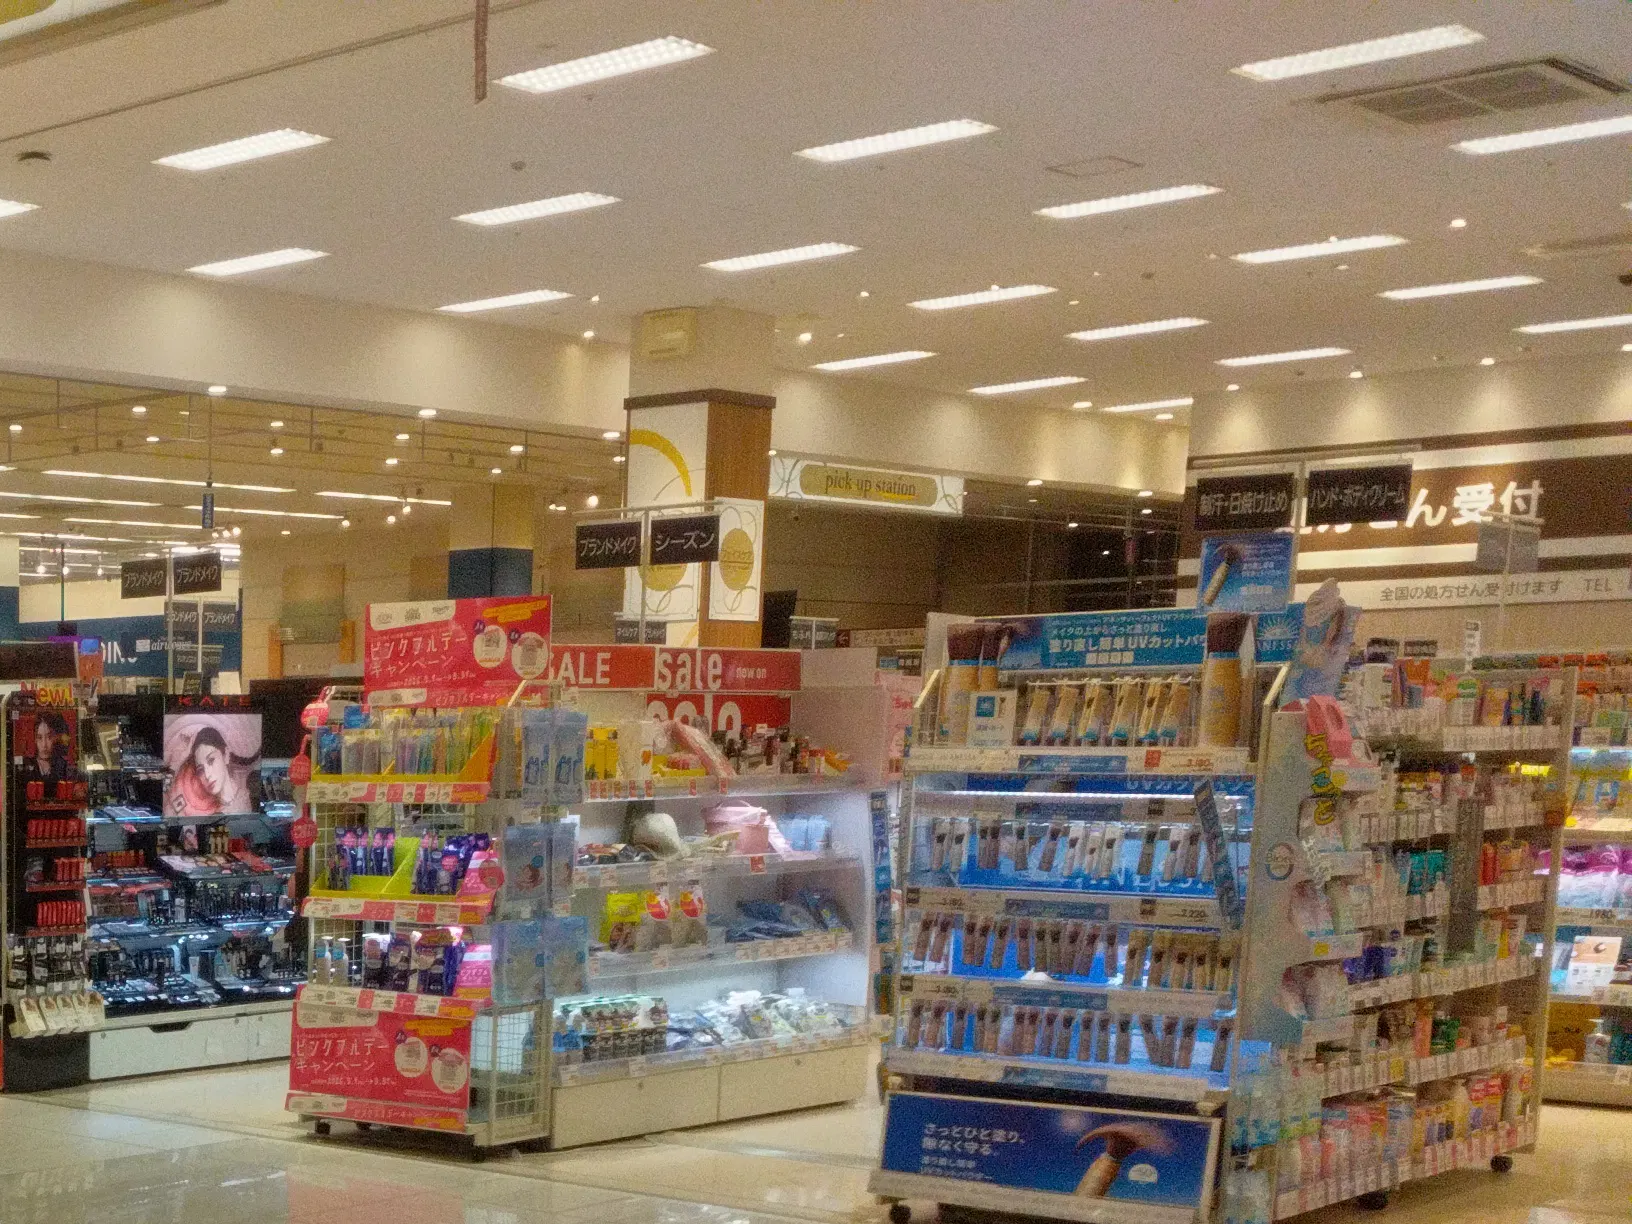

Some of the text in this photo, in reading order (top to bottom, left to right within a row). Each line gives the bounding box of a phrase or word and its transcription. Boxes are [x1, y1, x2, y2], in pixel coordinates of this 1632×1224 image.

[825, 469, 916, 497] pick up station
[580, 536, 637, 557] ブランドメイク
[655, 530, 715, 552] シーズン
[1583, 577, 1612, 592] TEL
[550, 651, 611, 686] ALE
[657, 650, 722, 692] sale
